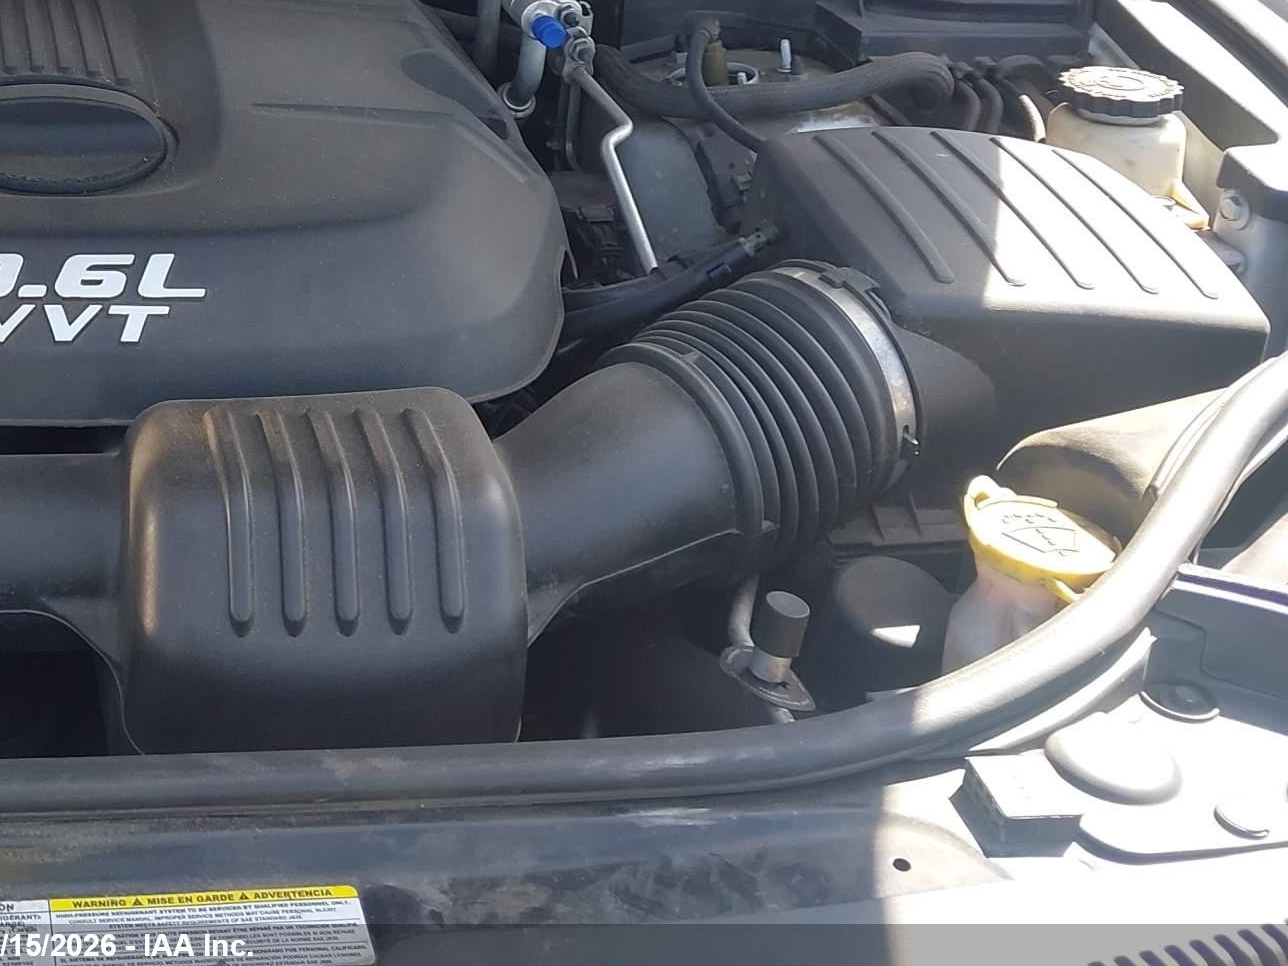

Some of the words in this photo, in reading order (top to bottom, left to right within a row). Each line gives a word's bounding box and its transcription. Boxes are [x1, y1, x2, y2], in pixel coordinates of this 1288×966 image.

[71, 900, 127, 909] WARNING
[147, 897, 175, 906] MISE
[196, 895, 235, 903] GARDE
[253, 890, 333, 901] ADVERTENCIA
